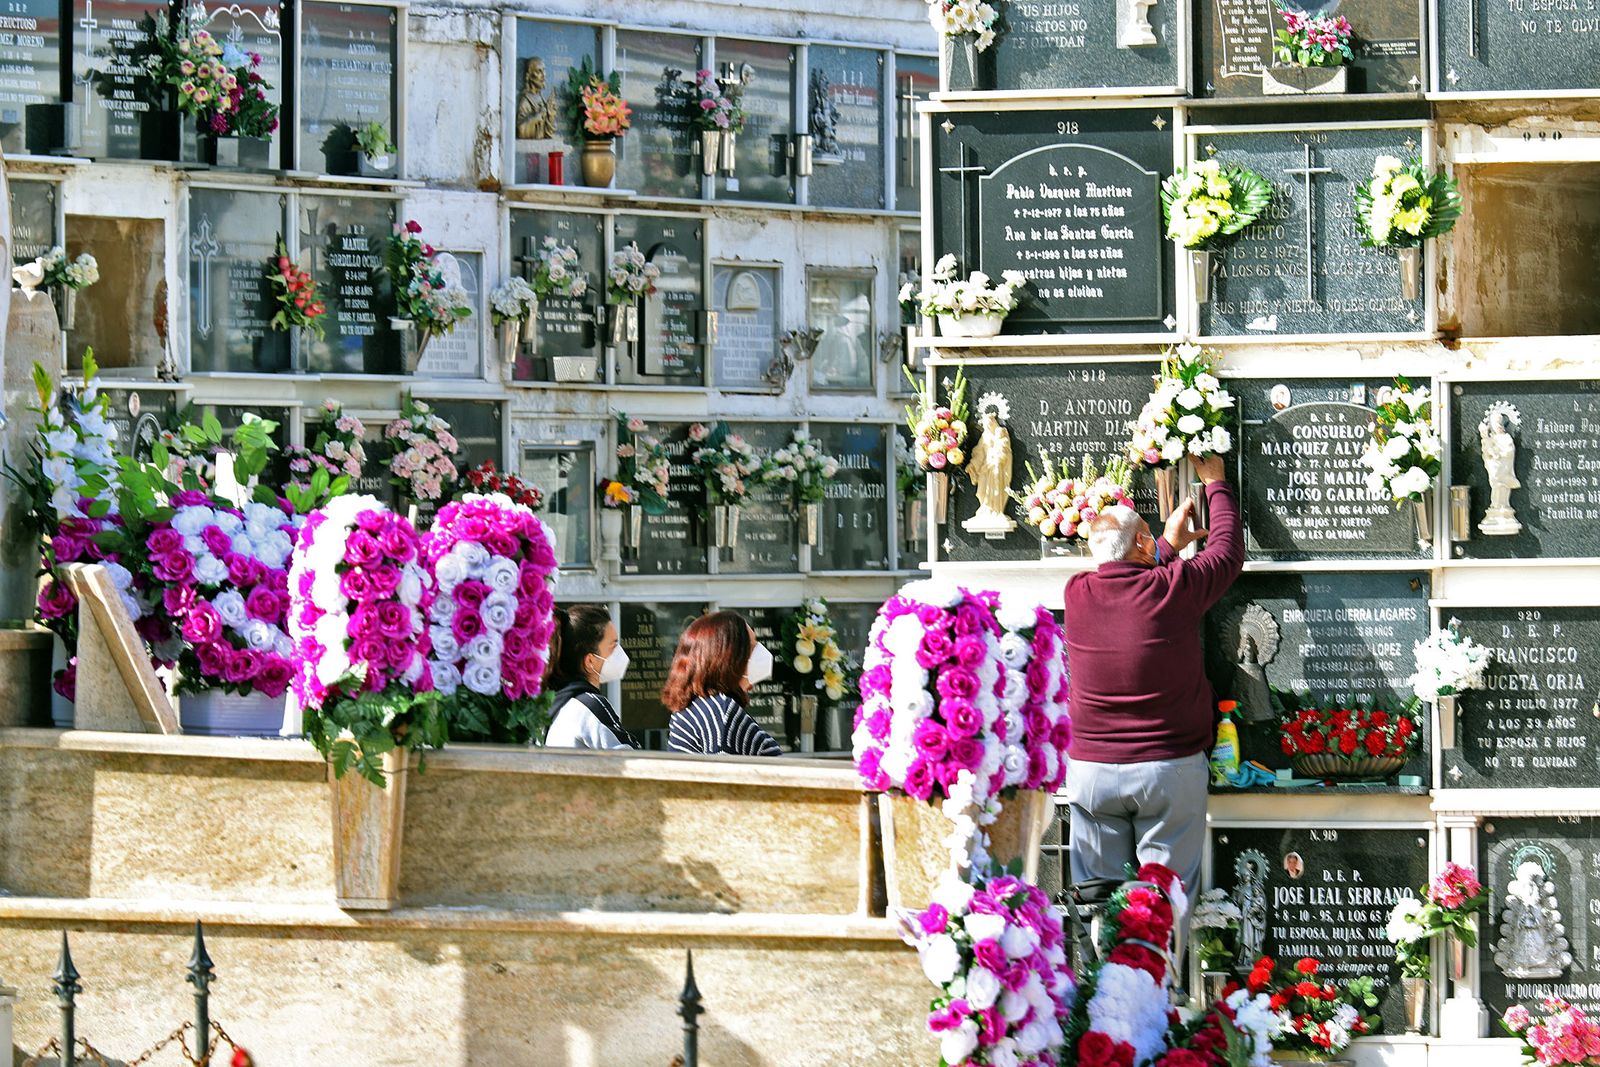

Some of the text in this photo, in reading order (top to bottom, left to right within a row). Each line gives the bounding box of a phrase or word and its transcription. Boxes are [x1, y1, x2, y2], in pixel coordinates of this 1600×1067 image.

[1017, 3, 1079, 17] TUS HIJOS
[1021, 19, 1087, 32] NIETOS NO
[1521, 19, 1562, 34] NO TE
[1012, 35, 1085, 49] TE OLVIDAN
[1057, 121, 1079, 135] 918
[1073, 204, 1088, 218] los
[1101, 203, 1125, 218] años
[1005, 225, 1026, 241] Ana
[1044, 227, 1059, 241] los
[1060, 224, 1097, 240] Santos
[1240, 226, 1285, 241] NIETO
[342, 237, 369, 251] MANUEL
[329, 253, 361, 268] GORDILLO
[1072, 246, 1124, 262] los años
[1059, 266, 1128, 282] hijos nietos
[1232, 263, 1270, 278] LOS 65
[1068, 285, 1104, 300] olvidan
[1214, 296, 1364, 314] SUS HIJOS NIETOS NO LES
[1328, 391, 1349, 401] 919
[1040, 399, 1132, 416] D. ANTONIO
[1030, 420, 1089, 437] MARTIN
[1292, 425, 1365, 440] CONSUELO
[1536, 417, 1575, 434] Isidoro
[1069, 441, 1106, 453] AGOSTO
[1261, 441, 1330, 458] MARQUEZ
[839, 453, 870, 469] FAMILIA
[1333, 460, 1350, 469] LOS
[1533, 454, 1573, 471] Aurelia
[1287, 471, 1369, 488] JOSE MARIA
[1267, 487, 1322, 501] RAPOSO
[1334, 504, 1390, 515] LOS AÑOS
[1285, 516, 1373, 531] SUS HIJOS NIETOS
[1292, 529, 1366, 540] NO LES OLVIDAN
[1283, 607, 1417, 623] ENRIQUETA GUERRA LAGARES
[1518, 610, 1541, 621] 920
[1374, 623, 1394, 637] AÑOS
[1502, 624, 1565, 639] D. E. P.
[1299, 643, 1402, 657] PEDRO ROMERO LOPEZ
[1374, 658, 1394, 671] AÑOS
[1290, 678, 1377, 690] VUESTROS NIETOS
[1547, 674, 1585, 691] ORIA
[1515, 698, 1546, 710] JULIO
[1553, 698, 1578, 710] 1977
[1498, 715, 1577, 731] LOS 39 AÑOS
[1477, 736, 1586, 749] TU ESPOSA E HIJOS
[1484, 757, 1577, 768] NO TE OLVIDAN
[1323, 829, 1338, 842] 919
[1323, 869, 1363, 882] D. E. P.
[1273, 886, 1414, 912] JOSE LEAL SERRANO
[1348, 909, 1367, 922] LOS
[1370, 909, 1381, 922] 65
[1272, 926, 1287, 940] TU
[1327, 944, 1343, 956] NO
[1346, 944, 1359, 957] TE
[1336, 960, 1376, 977] siempre
[1376, 963, 1390, 974] en
